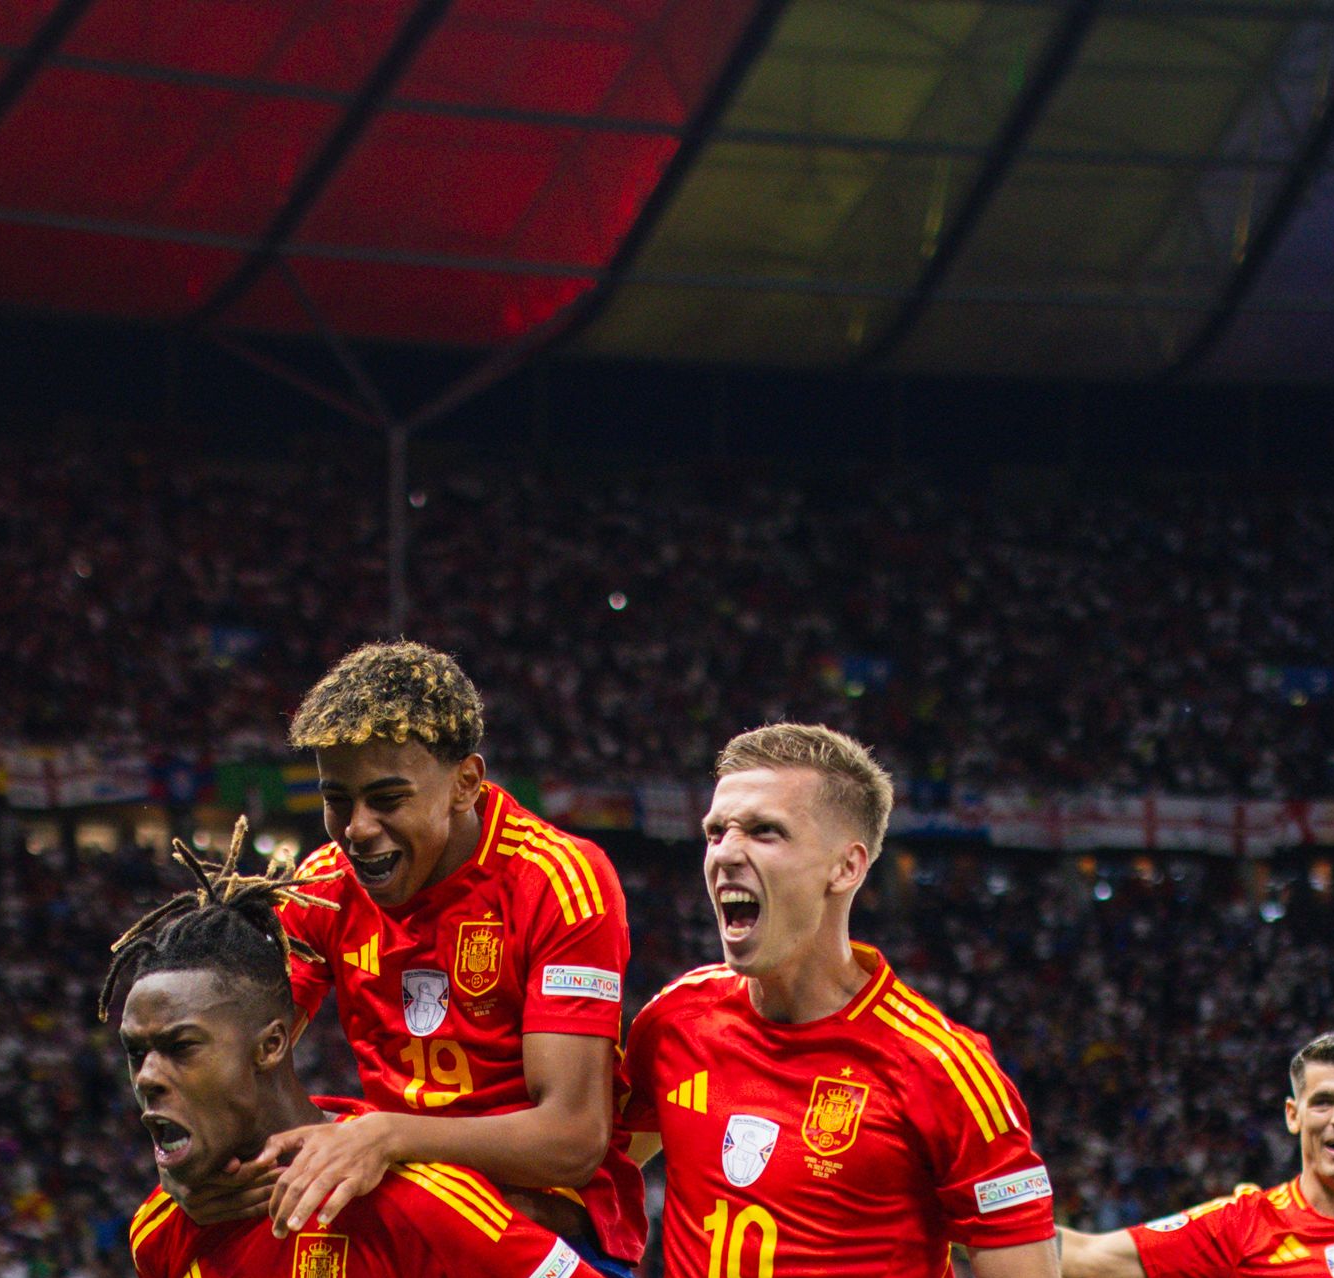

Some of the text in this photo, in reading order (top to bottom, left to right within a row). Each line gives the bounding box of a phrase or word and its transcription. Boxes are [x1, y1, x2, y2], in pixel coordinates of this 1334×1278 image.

[545, 975, 618, 992] FOUNDATION
[400, 1038, 473, 1108] 19
[979, 1175, 1048, 1204] FOUNDATION
